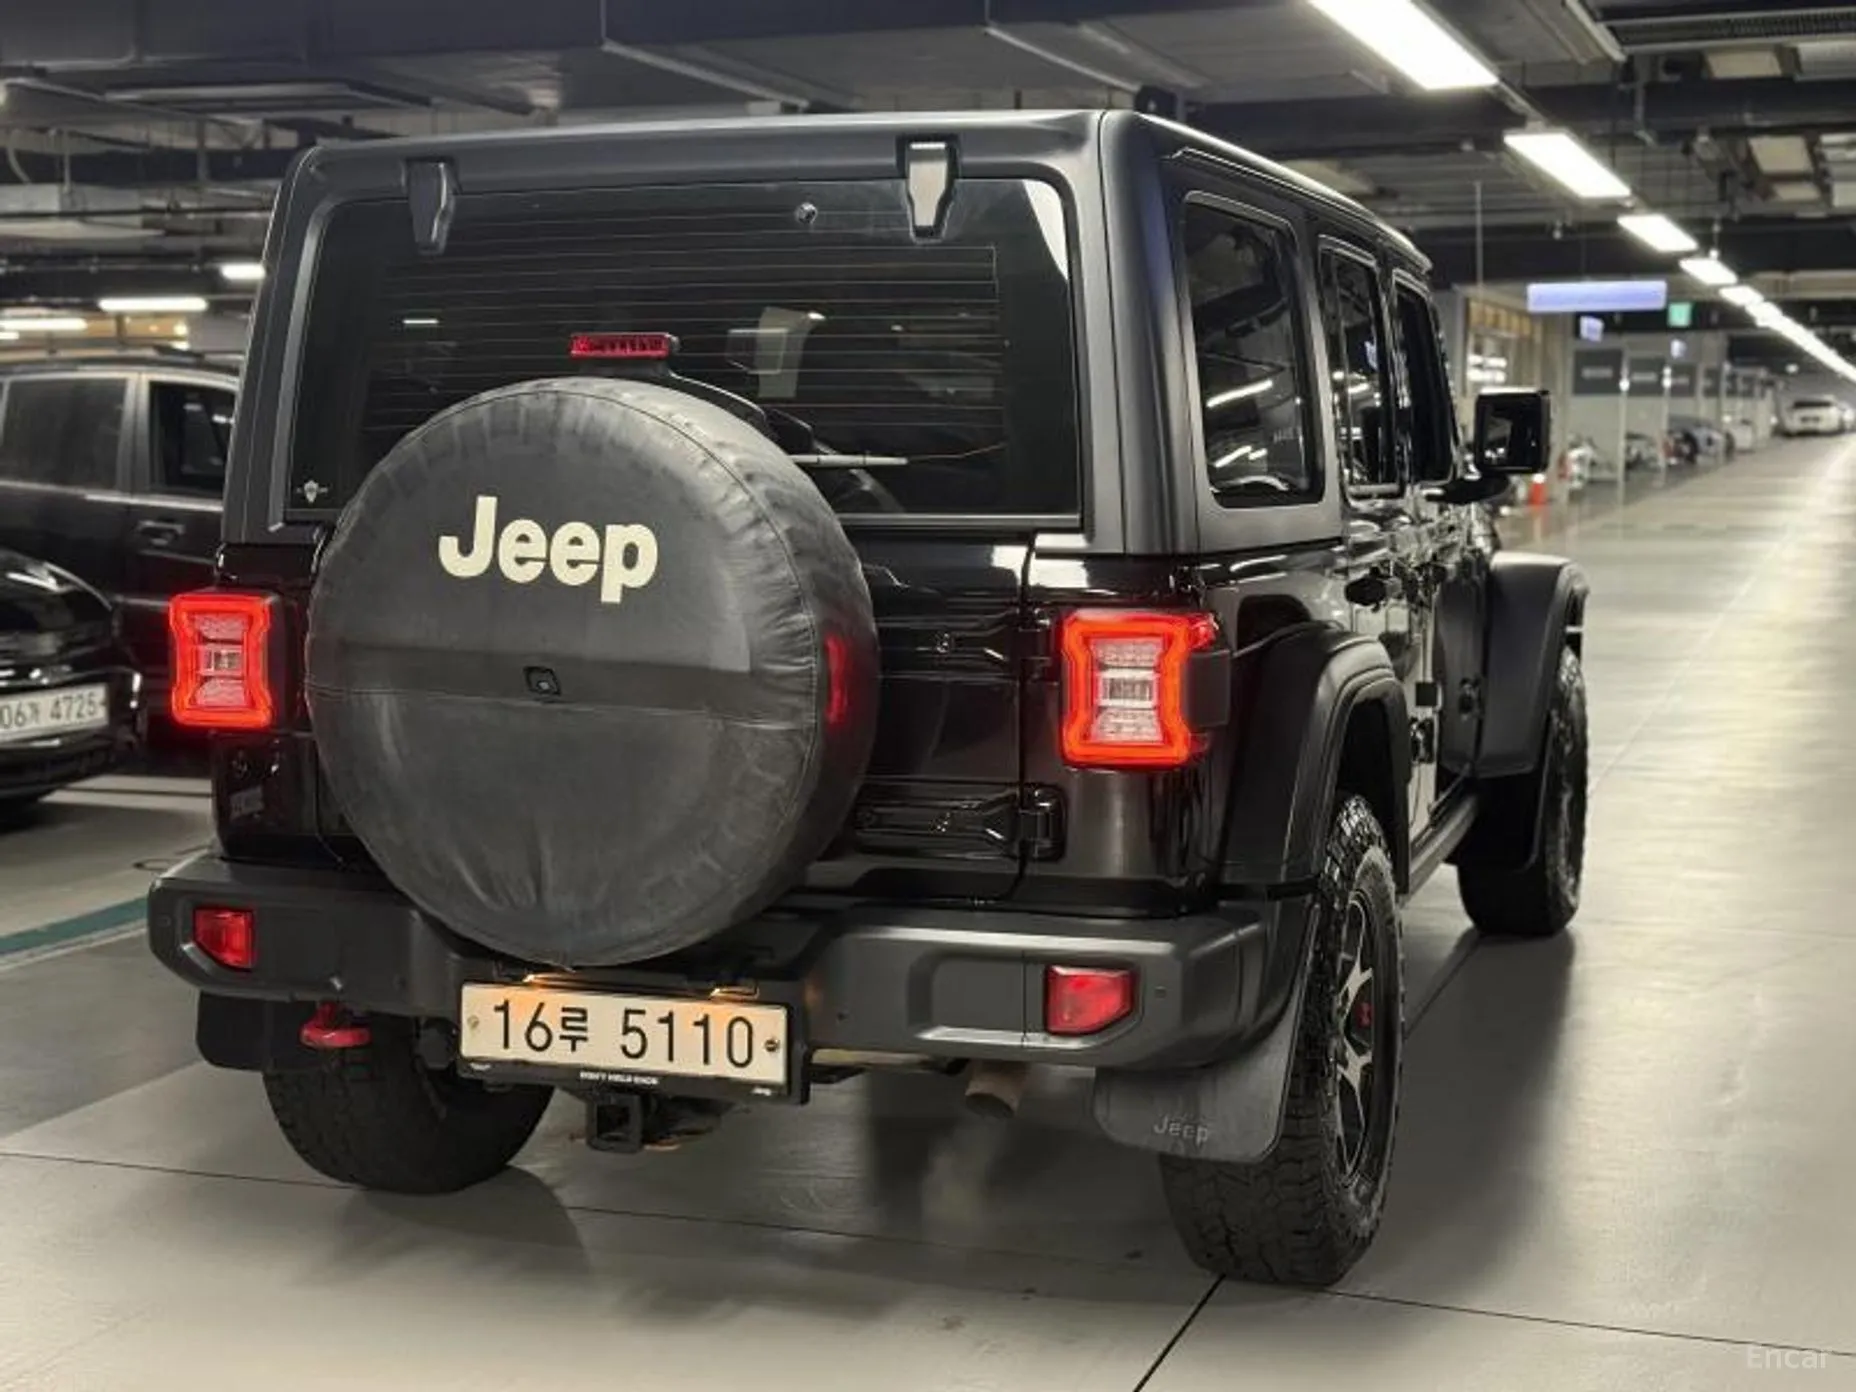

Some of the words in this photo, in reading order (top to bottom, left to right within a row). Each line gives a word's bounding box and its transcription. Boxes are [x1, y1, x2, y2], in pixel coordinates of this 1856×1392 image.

[438, 494, 658, 604] Jeep
[49, 690, 98, 721] 4725
[493, 999, 589, 1054] 16루
[620, 1007, 754, 1069] 5110
[1153, 1116, 1209, 1146] Jeep
